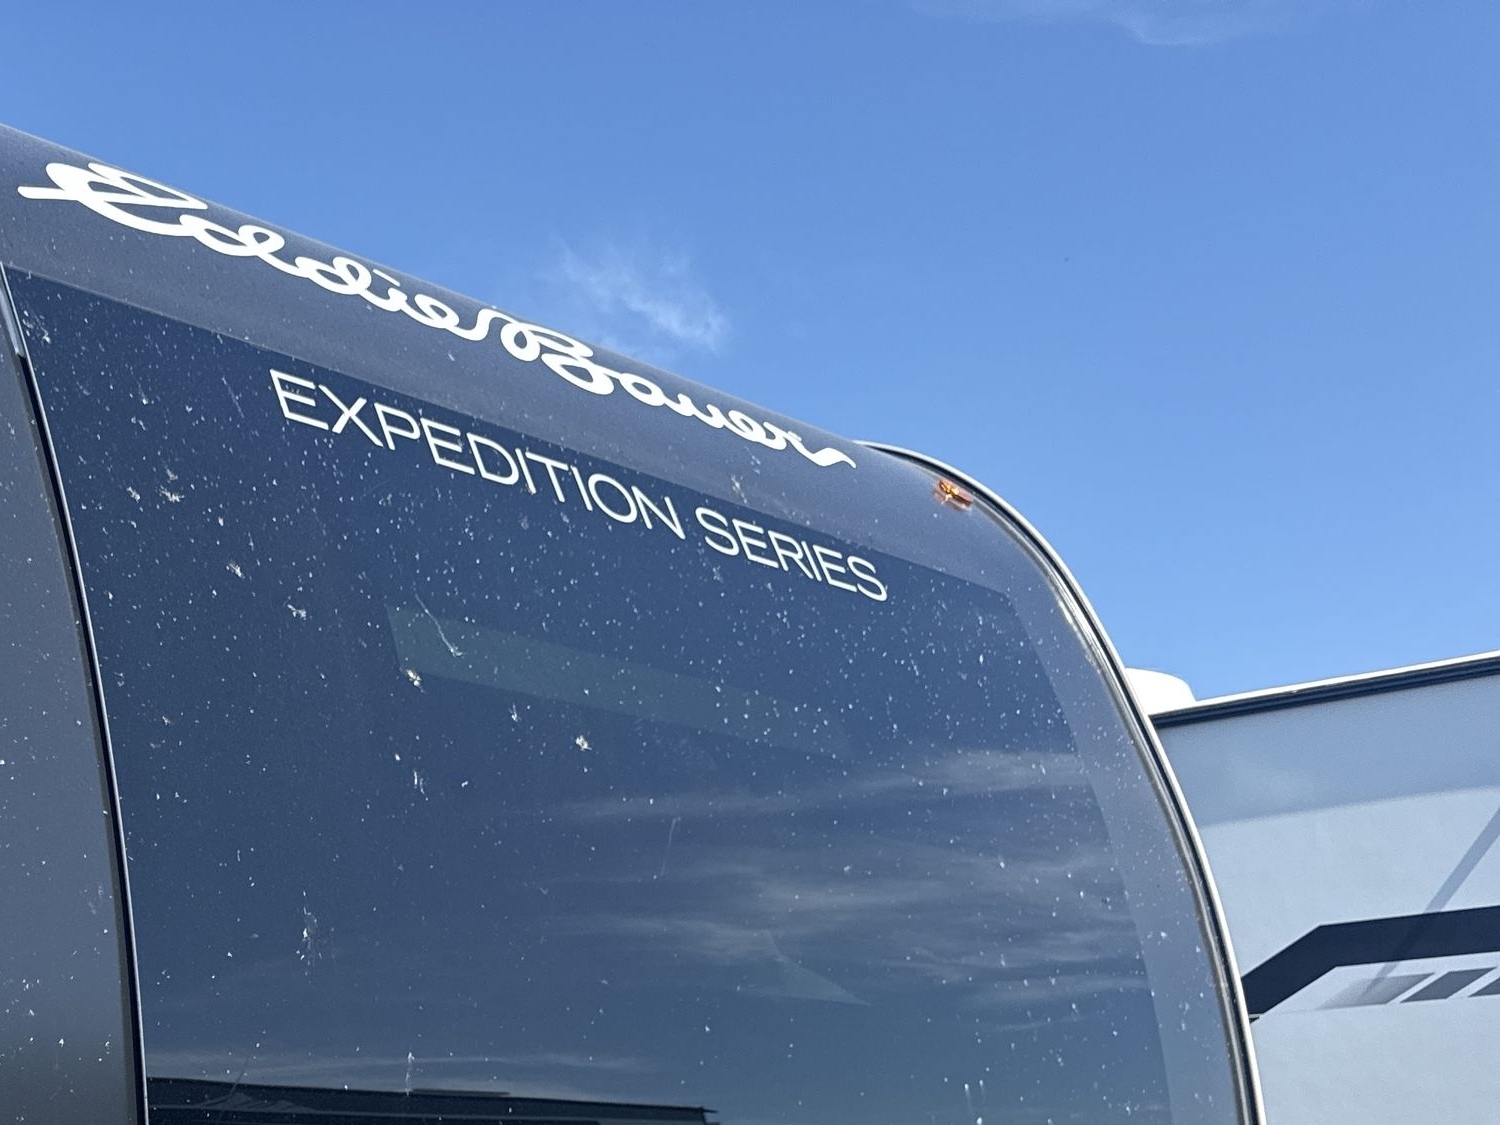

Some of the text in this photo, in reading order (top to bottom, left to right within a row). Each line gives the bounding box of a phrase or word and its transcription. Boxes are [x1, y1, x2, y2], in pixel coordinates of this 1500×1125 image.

[17, 160, 858, 470] Eddie Bauer
[268, 368, 889, 603] EXPEDITION SERIES
